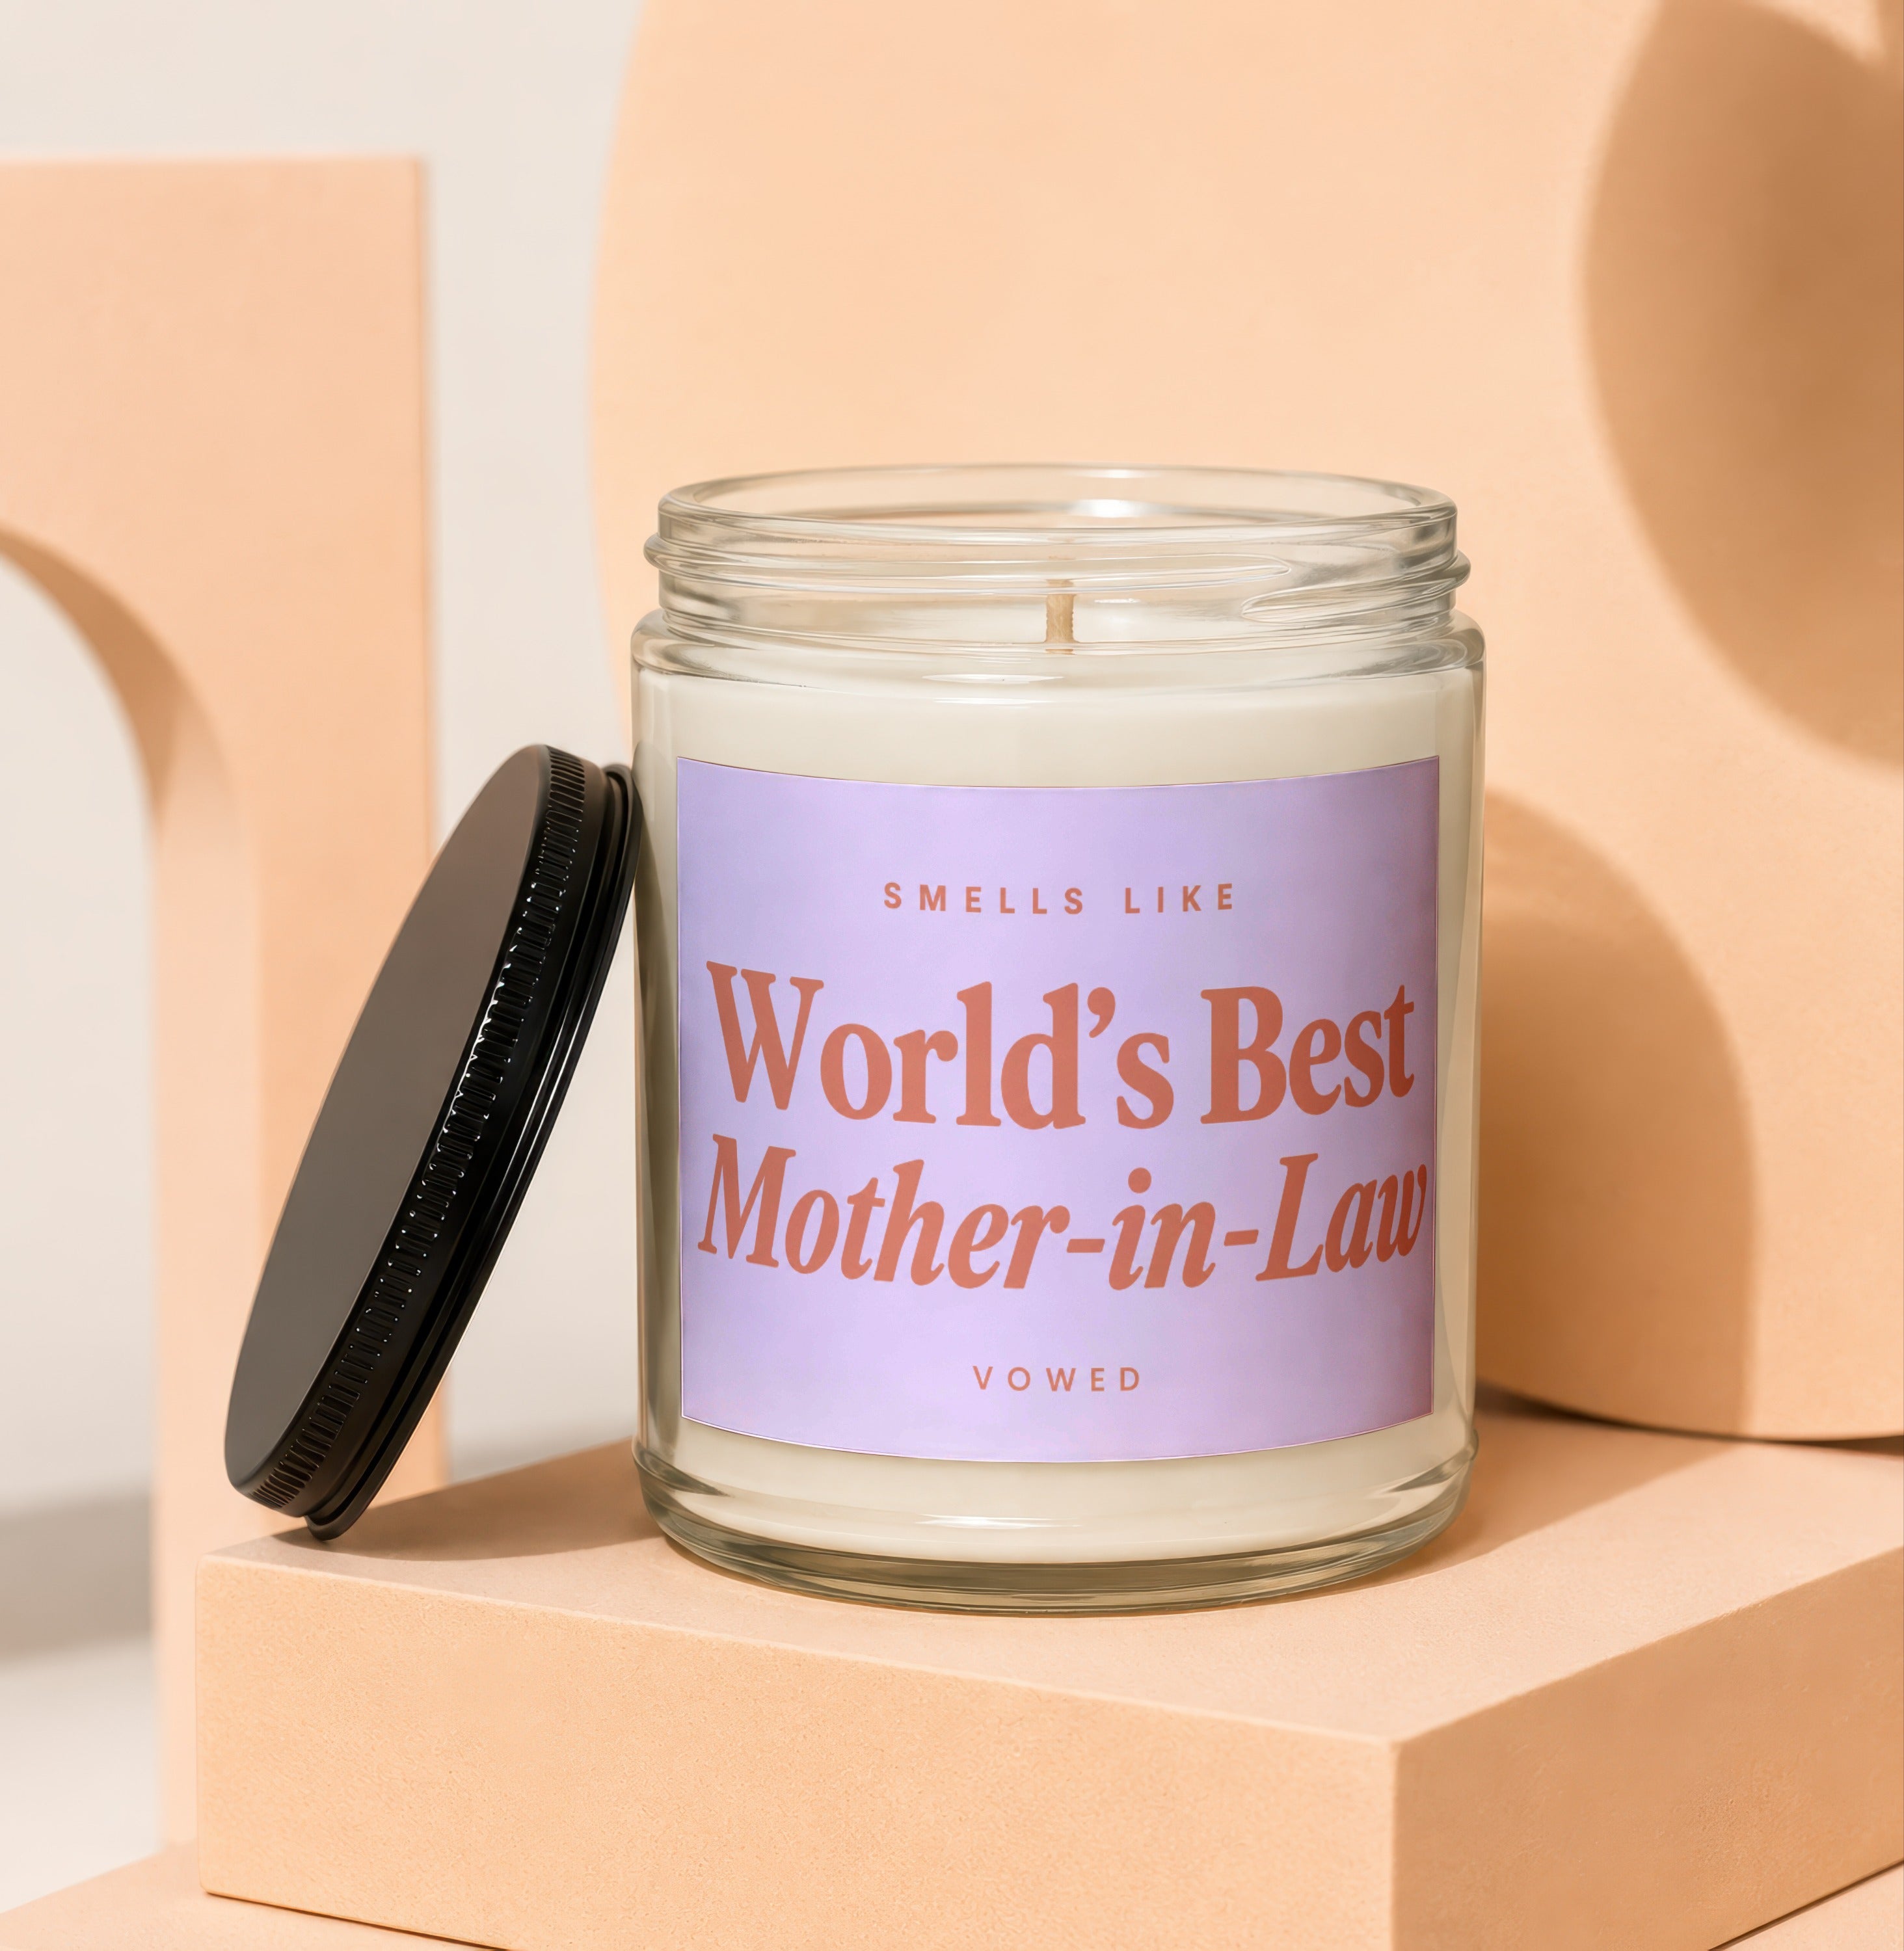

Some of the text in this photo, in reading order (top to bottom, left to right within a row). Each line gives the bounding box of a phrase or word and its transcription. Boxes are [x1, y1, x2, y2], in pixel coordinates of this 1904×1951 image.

[883, 881, 1234, 916] SMELLS LIKE
[705, 960, 1415, 1131] World’s Best
[697, 1133, 1427, 1291] Mother-in-Law
[971, 1364, 1141, 1393] VOWED
